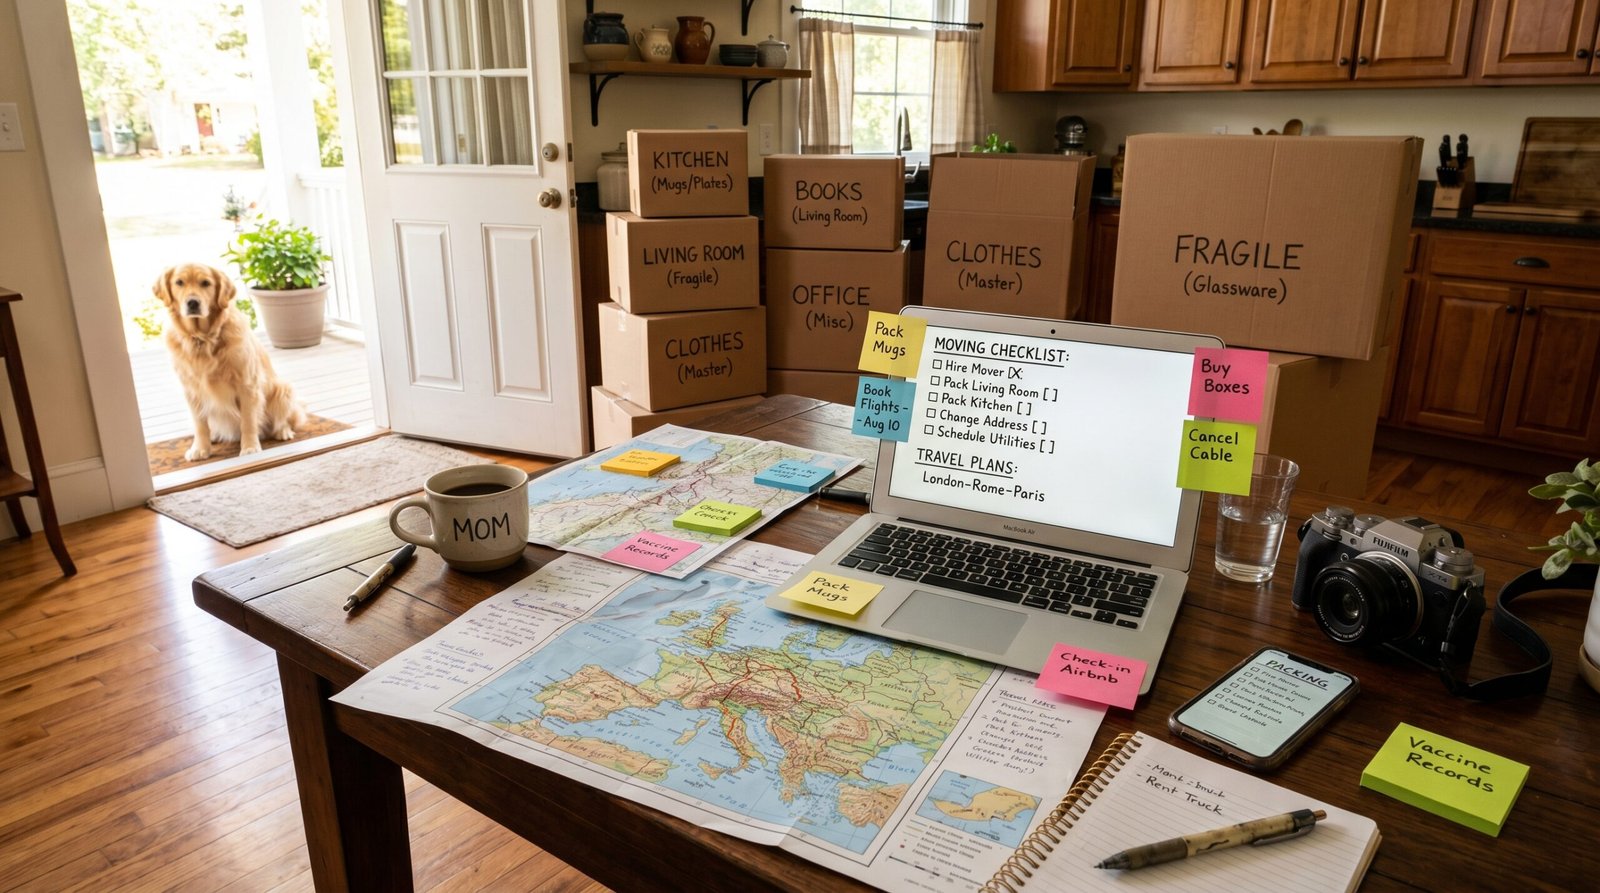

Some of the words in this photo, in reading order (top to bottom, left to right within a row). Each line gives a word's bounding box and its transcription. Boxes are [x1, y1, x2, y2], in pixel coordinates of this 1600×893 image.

[652, 150, 730, 169] KITCHEN
[651, 174, 734, 194] (Mugs/Plates)
[794, 180, 862, 200] BOOKS
[792, 206, 831, 227] (Living
[834, 208, 868, 226] Room)
[643, 246, 698, 266] LIVING
[702, 244, 745, 262] ROOM
[946, 240, 1042, 269] CLOTHES
[1174, 233, 1304, 271] FRAGILE
[666, 270, 720, 289] (Fragile)
[957, 268, 1023, 295] (Master)
[1183, 270, 1288, 304] (Glassware)
[792, 283, 871, 307] OFFICE
[804, 310, 854, 332] (Misc)
[874, 321, 904, 338] Pack
[664, 330, 744, 360] CLOTHES
[872, 340, 906, 360] Mugs
[934, 336, 986, 354] MOVING
[990, 342, 1070, 362] CHECKLIST:
[677, 356, 734, 384] (Master)
[945, 360, 968, 373] Hire
[971, 362, 1004, 377] Mover
[1200, 358, 1231, 378] Buy
[863, 383, 892, 398] Book
[943, 376, 968, 390] Pack
[972, 379, 1005, 398] Living
[1008, 384, 1039, 399] Room
[1203, 378, 1250, 395] Boxes
[860, 398, 900, 416] Flights
[941, 392, 967, 407] Pack
[970, 396, 1013, 412] Kitchen
[888, 420, 900, 432] 10
[939, 409, 980, 428] Change
[982, 414, 1028, 432] Address
[937, 425, 986, 443] Schedule
[990, 432, 1036, 450] Utilities
[1188, 428, 1238, 446] Cancel
[916, 447, 964, 467] TRAVEL
[970, 455, 1018, 474] PLANS:
[1190, 446, 1234, 463] Cable
[922, 470, 1046, 502] London-Rome-Paris
[452, 512, 511, 542] MOM
[1003, 524, 1027, 533] MacBook
[624, 544, 670, 561] Records
[636, 536, 680, 554] Vaccine
[1372, 536, 1409, 558] FUJIFILM
[806, 586, 849, 603] Mugs
[812, 576, 850, 592] Pack
[1060, 652, 1132, 674] Check-in
[1265, 659, 1330, 688] PACKING
[1060, 664, 1120, 684] Airbnb
[1409, 736, 1492, 774] Vaccine
[1405, 752, 1494, 793] Records
[1146, 775, 1178, 794] Rent
[1185, 792, 1223, 816] Truck
